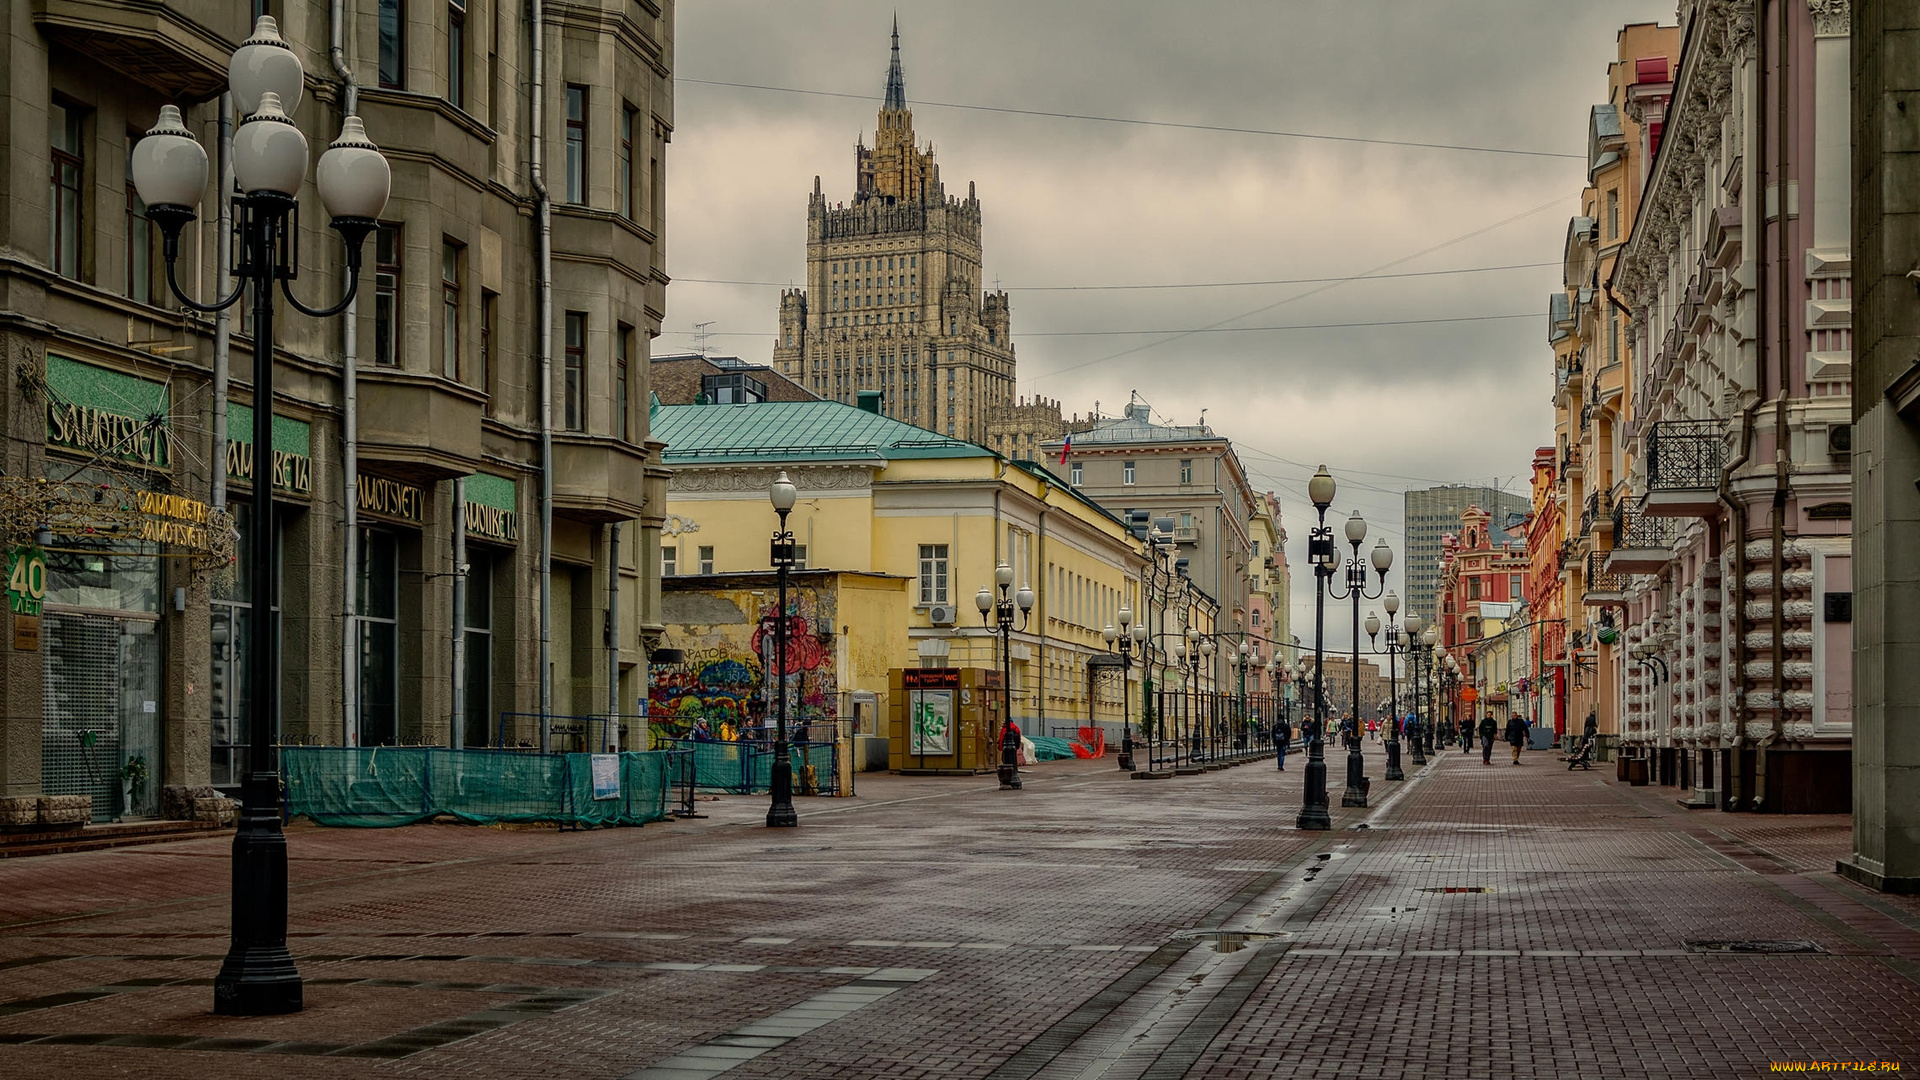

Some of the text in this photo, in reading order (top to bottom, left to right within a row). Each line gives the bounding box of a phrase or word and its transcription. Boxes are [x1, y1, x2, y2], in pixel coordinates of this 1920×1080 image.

[226, 438, 313, 492] АМВЕТЫ
[355, 474, 426, 521] AMOTSVETY
[464, 500, 519, 540] АМОЦВЕТЫ
[10, 554, 47, 600] 40
[14, 598, 42, 615] ЛЕТ
